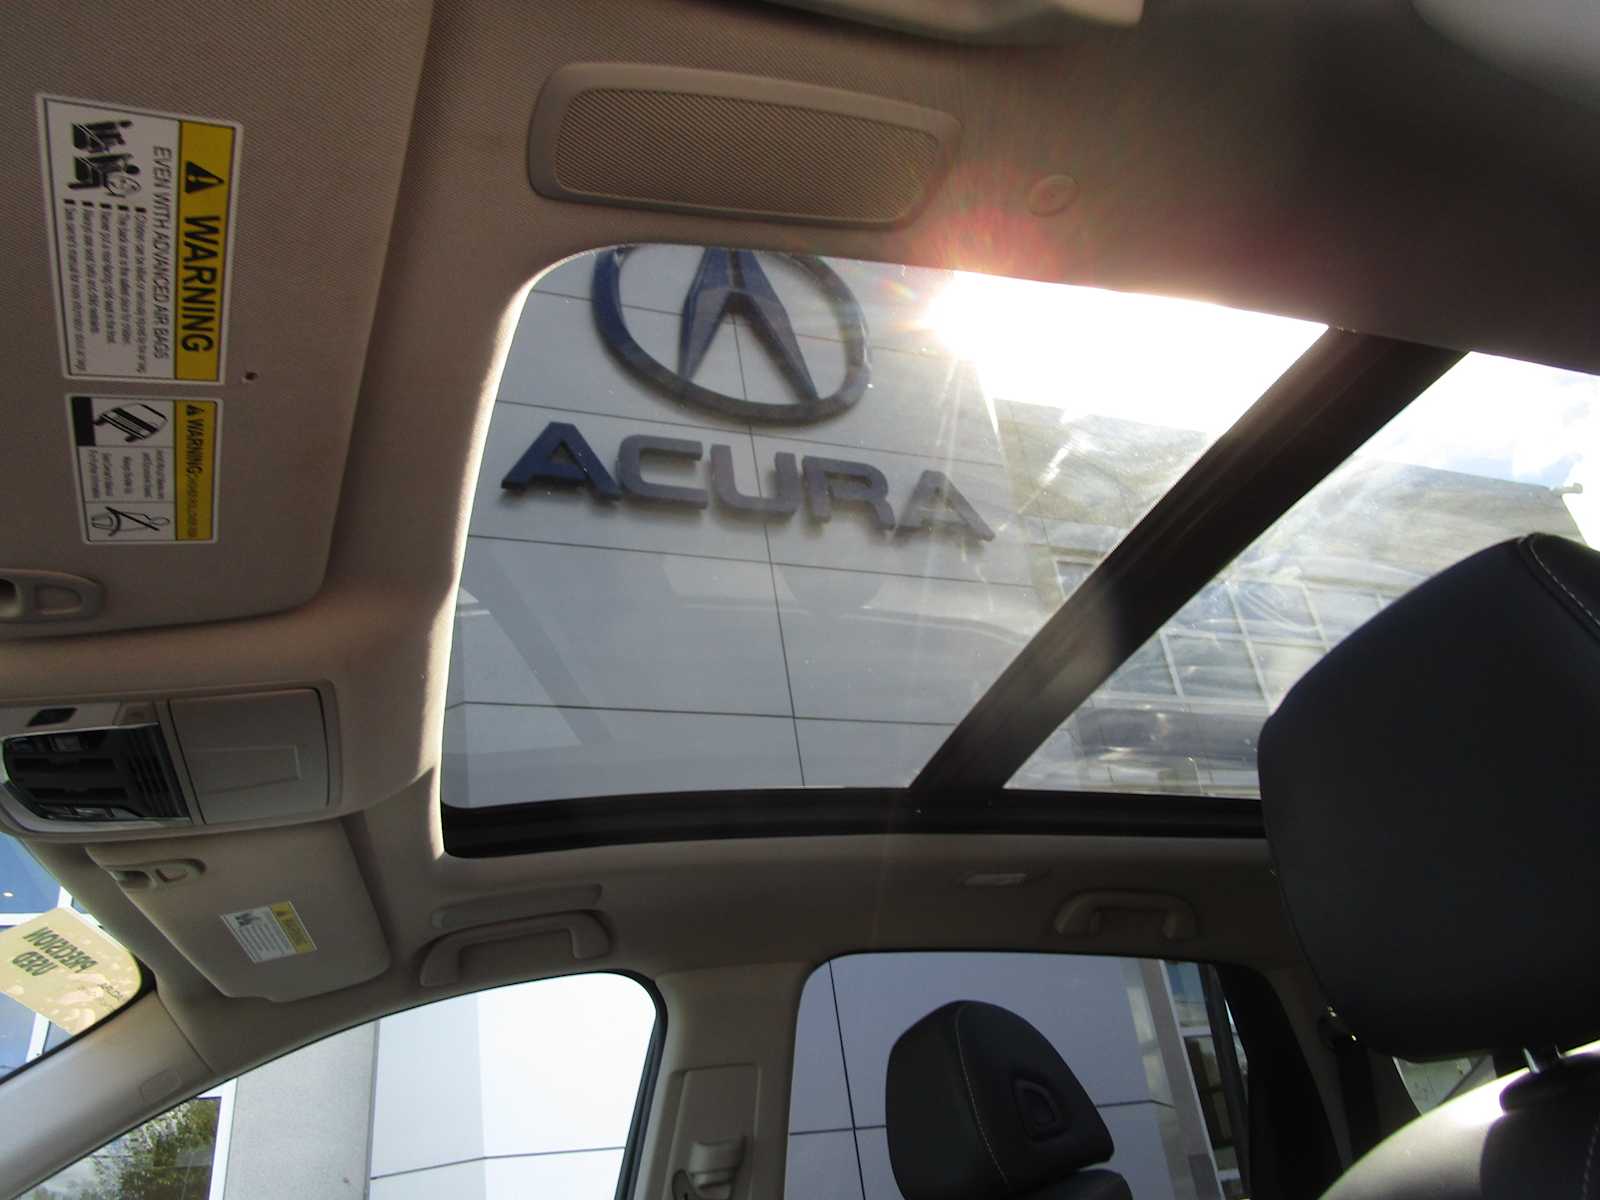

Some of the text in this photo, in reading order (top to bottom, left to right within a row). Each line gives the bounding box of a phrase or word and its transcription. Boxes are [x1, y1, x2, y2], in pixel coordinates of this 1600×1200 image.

[152, 146, 172, 359] EVEN WITH ADVANCED AIR BAGS
[182, 216, 222, 352] WARNING
[501, 421, 996, 541] ACURA
